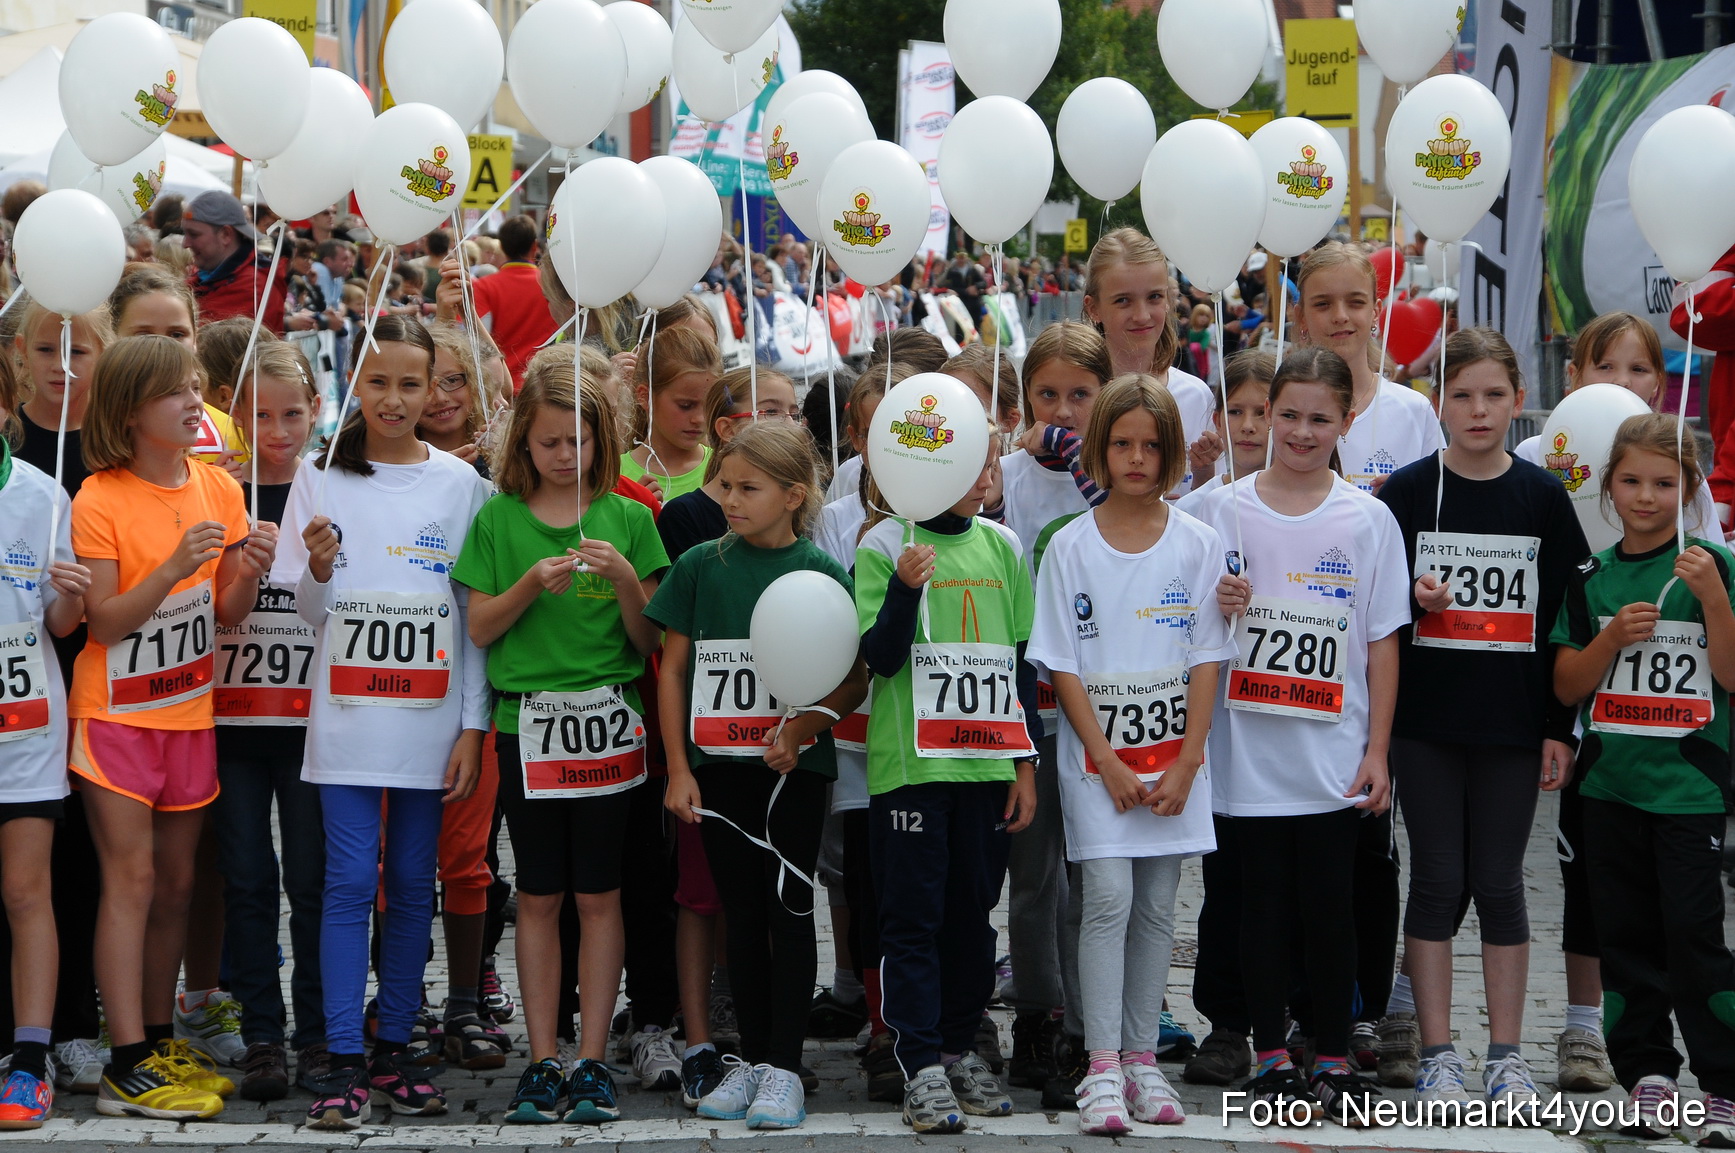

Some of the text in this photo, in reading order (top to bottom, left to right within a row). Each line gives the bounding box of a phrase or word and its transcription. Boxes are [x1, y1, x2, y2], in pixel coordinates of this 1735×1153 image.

[1288, 47, 1356, 69] Jugend-
[1306, 69, 1338, 86] lauf
[468, 135, 507, 150] Block
[471, 157, 499, 193] A
[1426, 166, 1468, 181] stiftung
[407, 180, 446, 203] stiftung
[1287, 184, 1325, 200] stiftung
[1422, 182, 1440, 190] lassen
[1464, 180, 1485, 189] steigen
[1281, 199, 1298, 207] lassen
[842, 233, 881, 247] stiftung
[1070, 228, 1082, 243] C
[839, 245, 855, 253] lassen
[855, 247, 875, 255] Träume
[875, 247, 896, 255] steigen
[897, 433, 939, 452] stiftung
[892, 448, 909, 458] lassen
[910, 453, 932, 462] Träume
[932, 457, 954, 465] steigen
[385, 545, 406, 557] 14.
[1420, 544, 1522, 559] PARTL Neumarkt
[932, 578, 1003, 589] Goldhutlauf 2012
[1286, 572, 1306, 584] 14.
[1302, 572, 1337, 580] Neumarkter
[152, 598, 200, 620] Neumarkt
[335, 601, 434, 616] PARTL Neumarkt
[1136, 607, 1153, 620] 14.
[1246, 606, 1335, 628] ARTL Neumarkt
[215, 624, 309, 637] PARTL Neumarkt
[1453, 615, 1484, 631] Hanna
[121, 614, 206, 674] 7170
[343, 618, 435, 663] 7001
[698, 652, 737, 663] PARTL
[963, 655, 1007, 669] Neumarkt
[1247, 627, 1337, 679] 7280
[220, 643, 315, 685] 7297
[149, 671, 193, 697] Merle
[367, 673, 411, 693] Julia
[1087, 676, 1179, 696] PARTL Neumarkt
[1239, 677, 1333, 707] Anna-Maria
[928, 671, 1012, 715] 7017
[214, 693, 253, 715] Emily
[524, 695, 622, 713] PARTL Neumarkt
[920, 709, 926, 717] 5
[1605, 699, 1694, 723] Cassandra
[1098, 694, 1187, 745] 7335
[532, 708, 634, 755] 7002
[950, 725, 1005, 745] Janika
[527, 752, 532, 760] 5
[558, 763, 621, 785] Jasmin
[890, 809, 923, 832] 112
